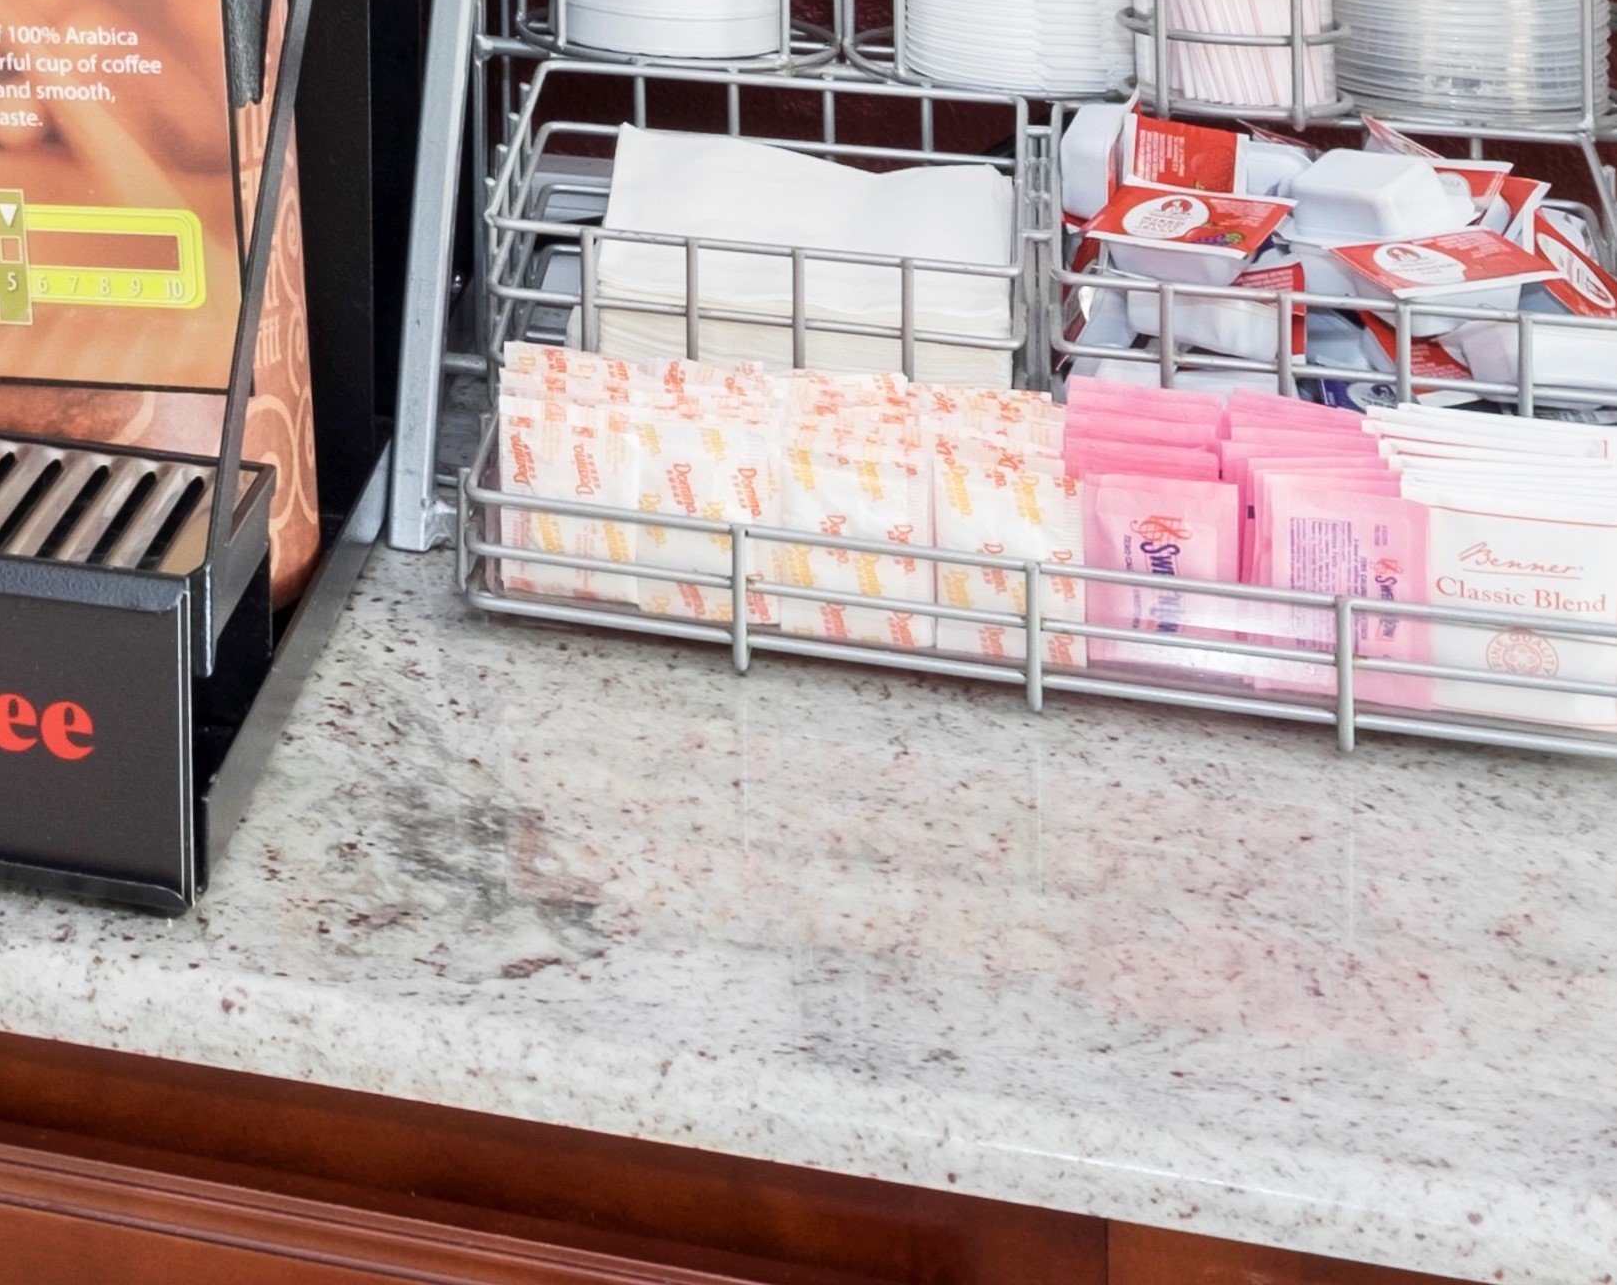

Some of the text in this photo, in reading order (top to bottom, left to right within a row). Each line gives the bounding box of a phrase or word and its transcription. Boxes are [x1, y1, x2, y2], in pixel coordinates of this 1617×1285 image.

[8, 26, 60, 45] 100%
[65, 26, 139, 46] Arabica
[35, 56, 72, 76] cup
[77, 53, 98, 73] of
[102, 54, 163, 74] coffee
[36, 82, 116, 103] smooth,
[7, 271, 17, 291] 5
[573, 442, 596, 497] Domino
[673, 461, 698, 514] Domino
[738, 466, 762, 517] Domino
[1436, 576, 1607, 613] Classic Blend
